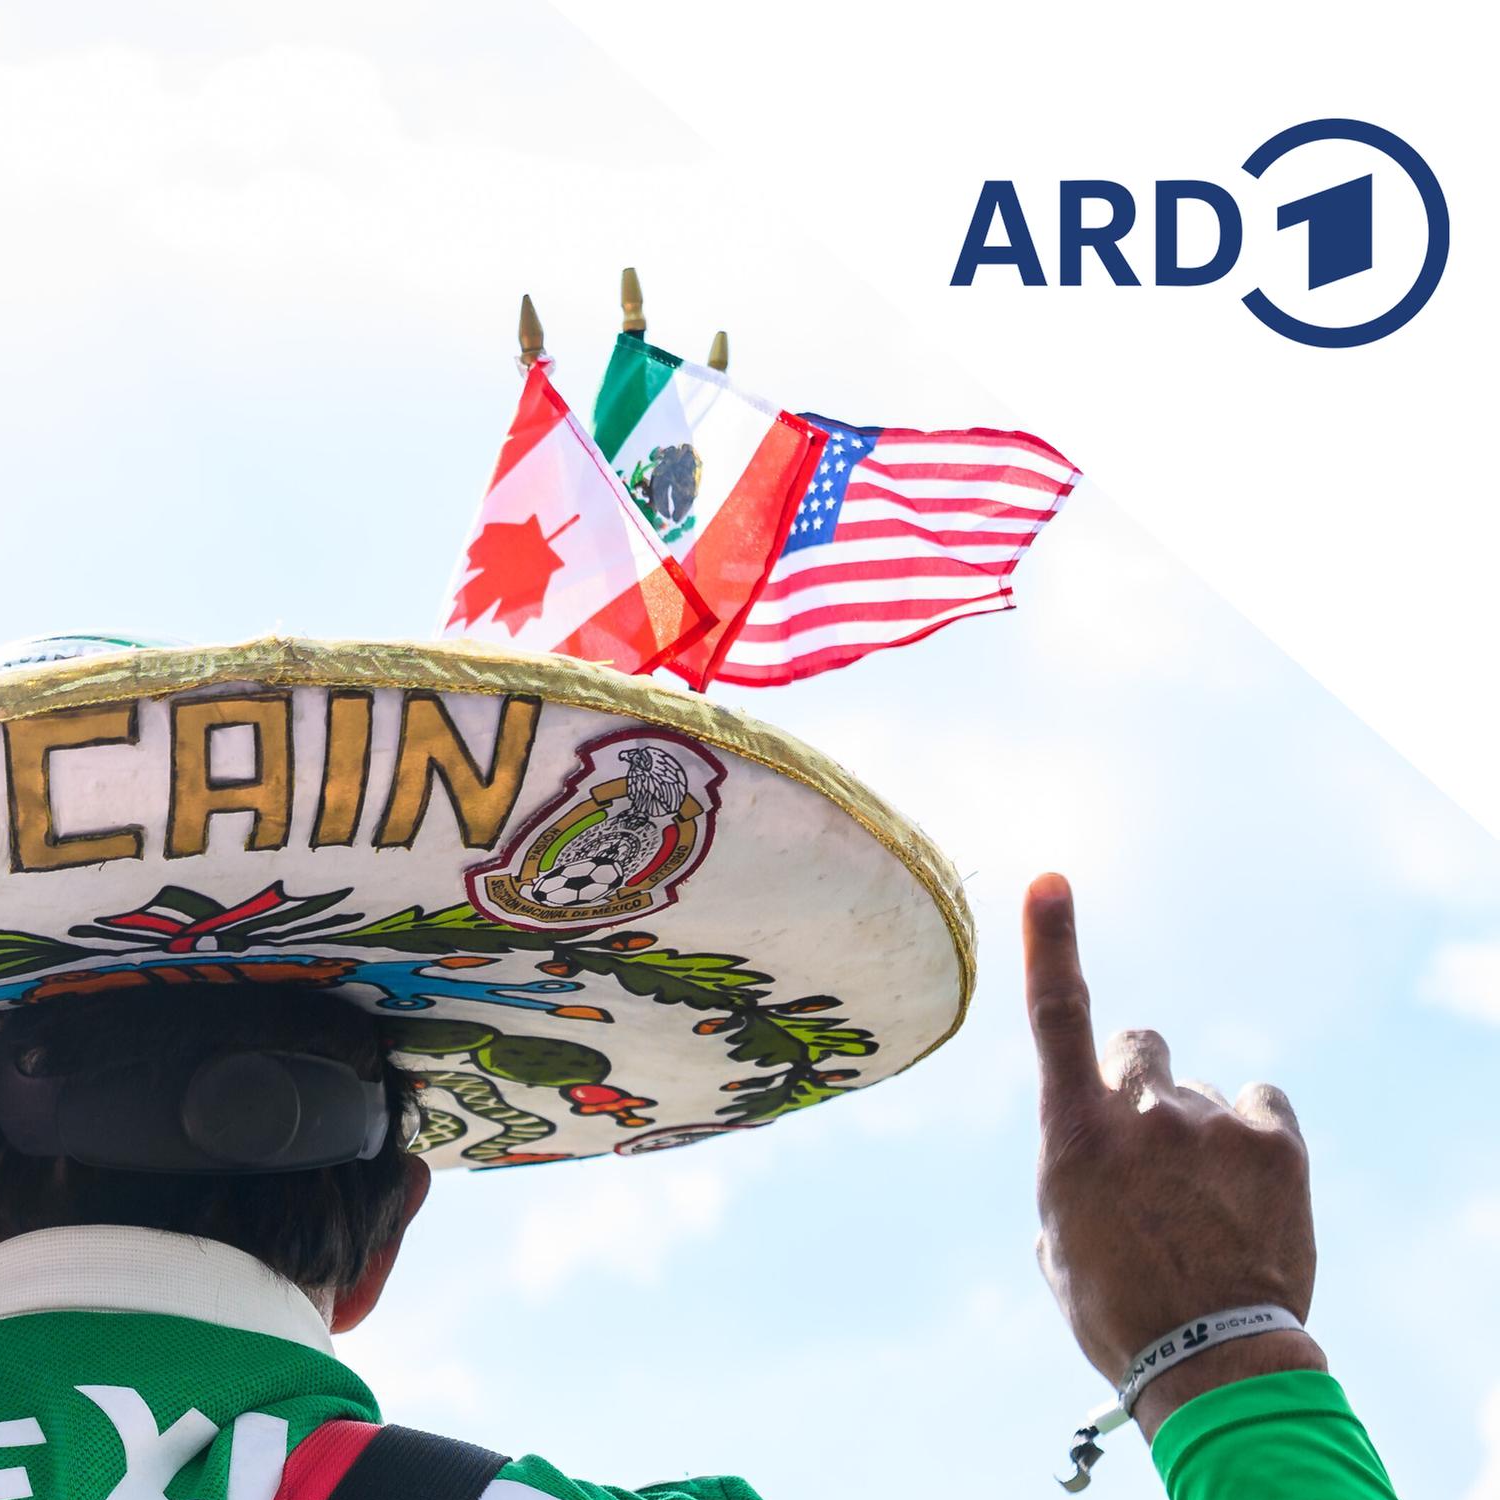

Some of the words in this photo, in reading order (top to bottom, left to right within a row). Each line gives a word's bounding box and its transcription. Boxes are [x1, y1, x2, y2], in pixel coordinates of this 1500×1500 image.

[1, 687, 543, 874] CAIN
[570, 910, 591, 918] DE
[1215, 1313, 1273, 1332] ESTADIO
